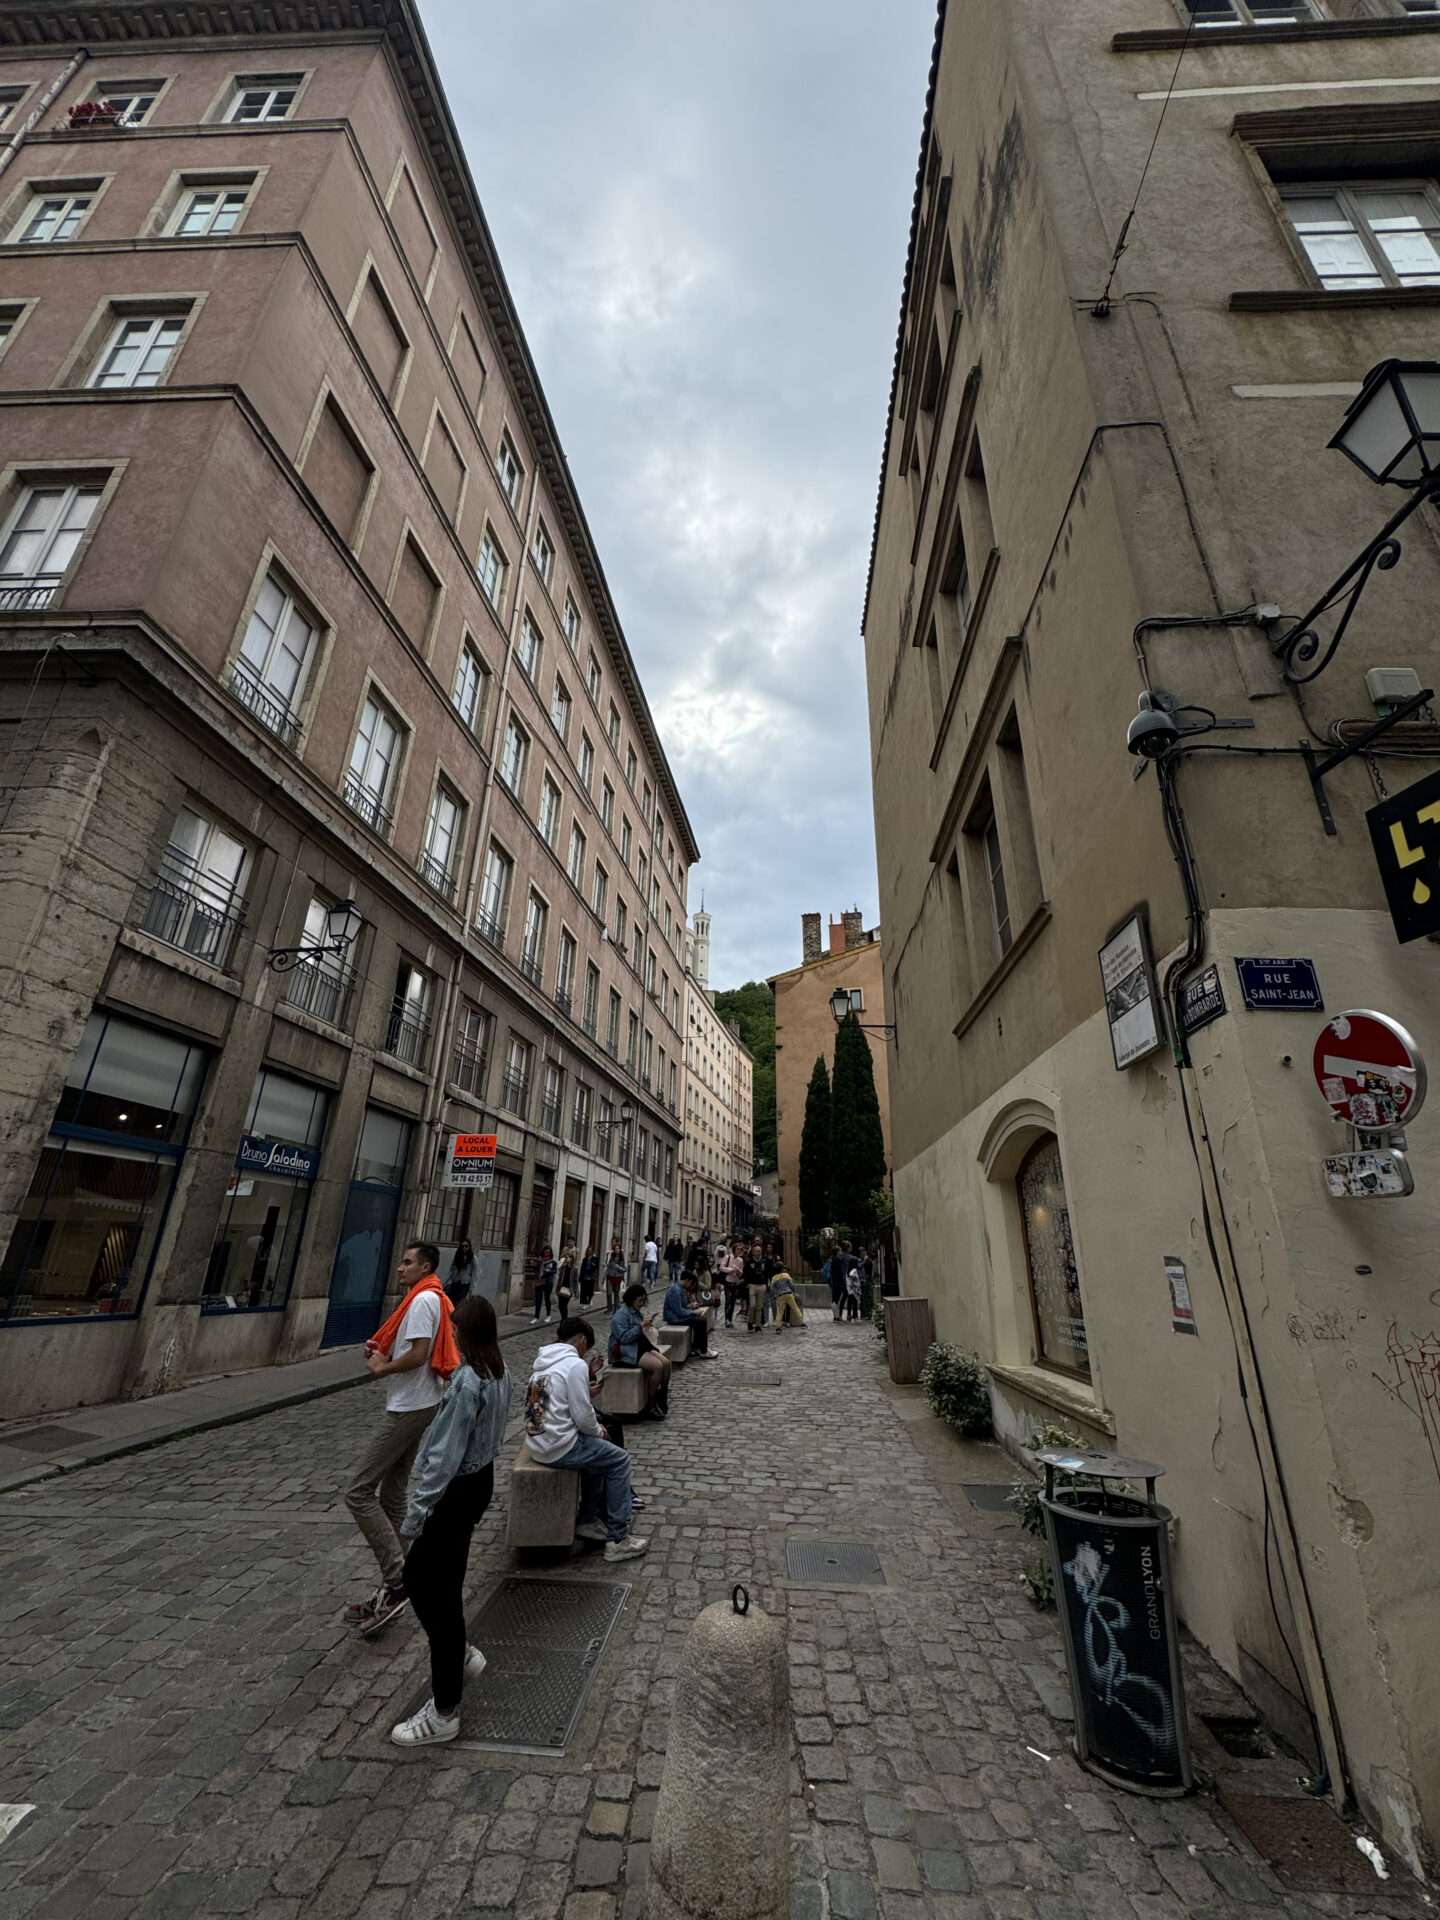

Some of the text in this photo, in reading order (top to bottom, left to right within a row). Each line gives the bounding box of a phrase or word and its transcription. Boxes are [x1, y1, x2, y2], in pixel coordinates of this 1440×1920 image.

[1263, 973, 1292, 983] RUE
[1186, 984, 1204, 1003] RUE
[1250, 988, 1315, 1000] SAINT-JEAN
[241, 1140, 267, 1160] Bruno
[453, 1158, 492, 1167] OMNIUM
